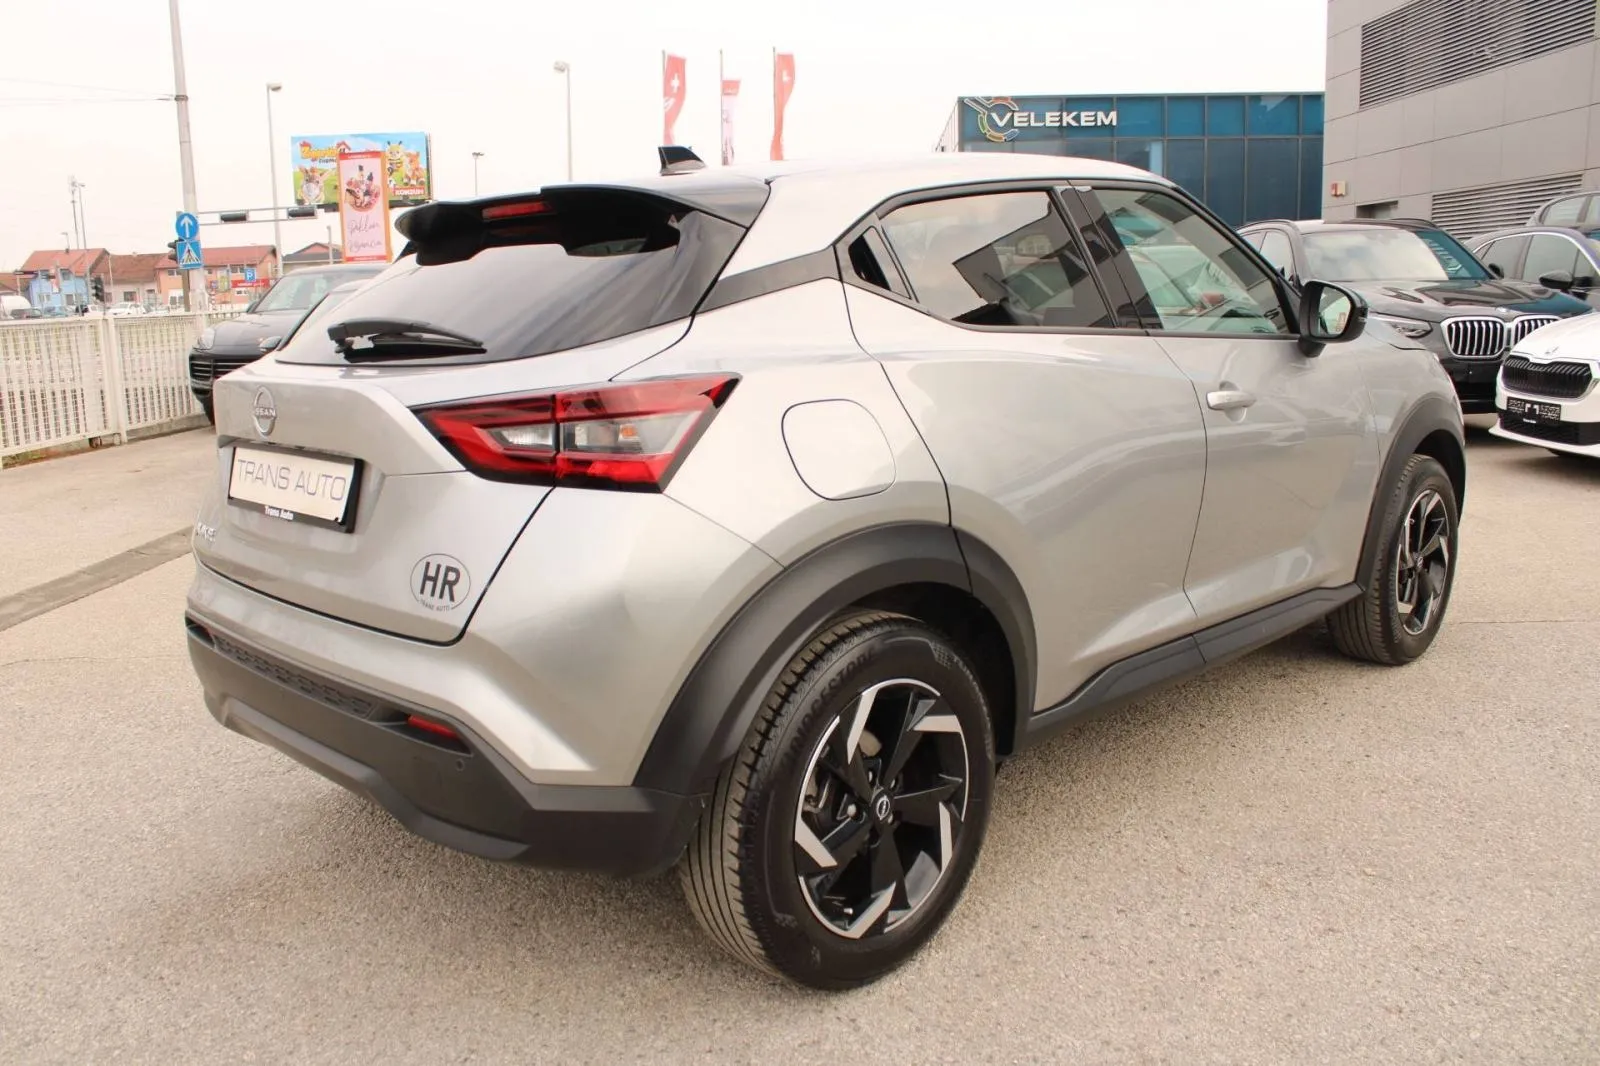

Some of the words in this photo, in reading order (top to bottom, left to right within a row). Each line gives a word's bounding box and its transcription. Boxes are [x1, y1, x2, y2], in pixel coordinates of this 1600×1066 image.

[990, 111, 1117, 127] VELEKEM
[237, 459, 290, 490] TRANS
[294, 470, 347, 501] AUTO
[264, 505, 279, 517] Trans
[280, 509, 294, 520] Auto
[420, 561, 461, 602] HR
[779, 642, 881, 767] RIDGESTONE
